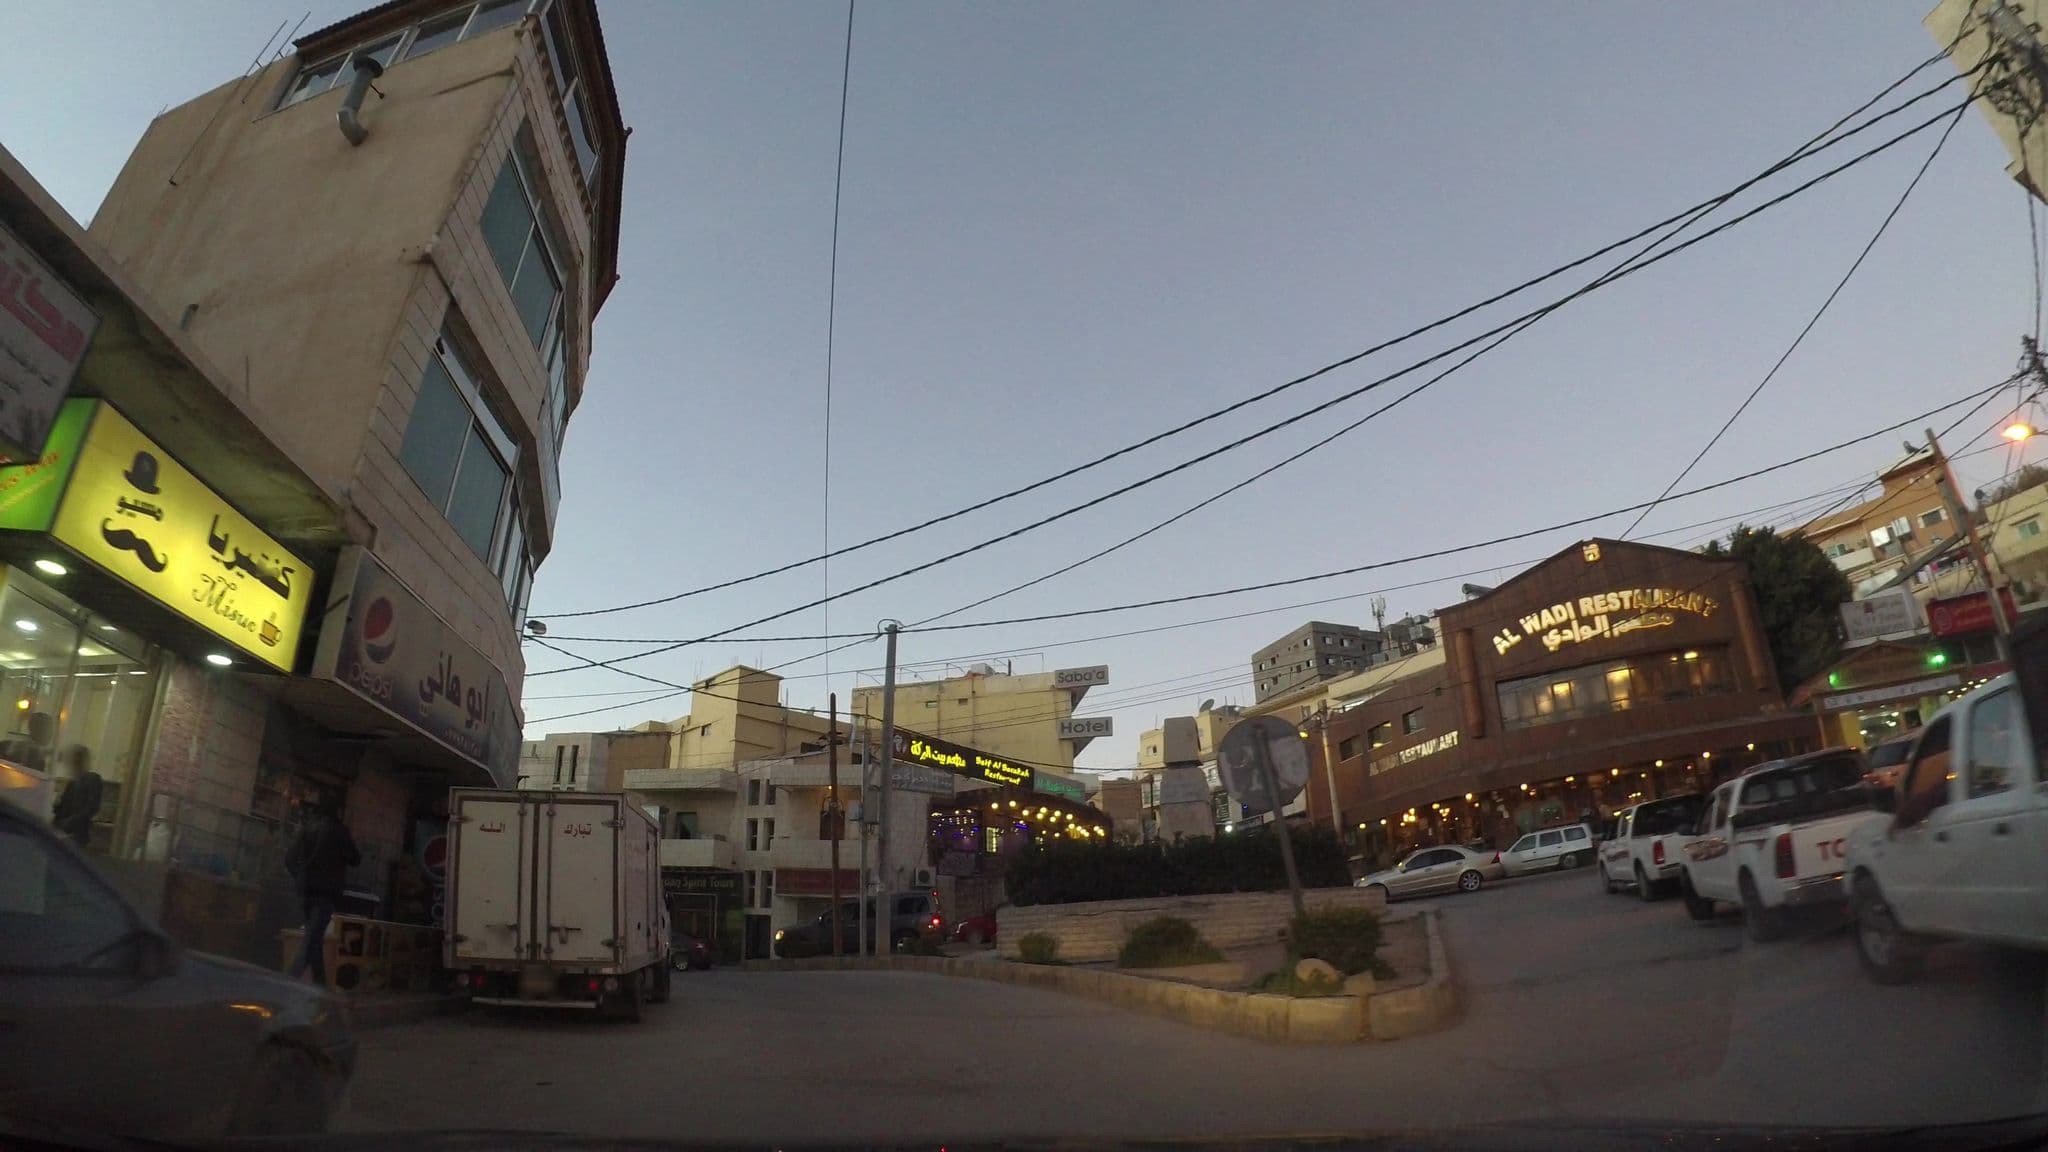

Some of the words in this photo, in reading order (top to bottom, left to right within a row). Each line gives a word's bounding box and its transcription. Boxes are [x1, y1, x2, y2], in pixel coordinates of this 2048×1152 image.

[1492, 627, 1522, 655] AL
[1519, 602, 1576, 635] WADI
[1578, 588, 1719, 618] RESTAURANT
[1541, 614, 1611, 652] الوادي
[1061, 720, 1109, 734] Hotel
[563, 823, 592, 838] تبارك
